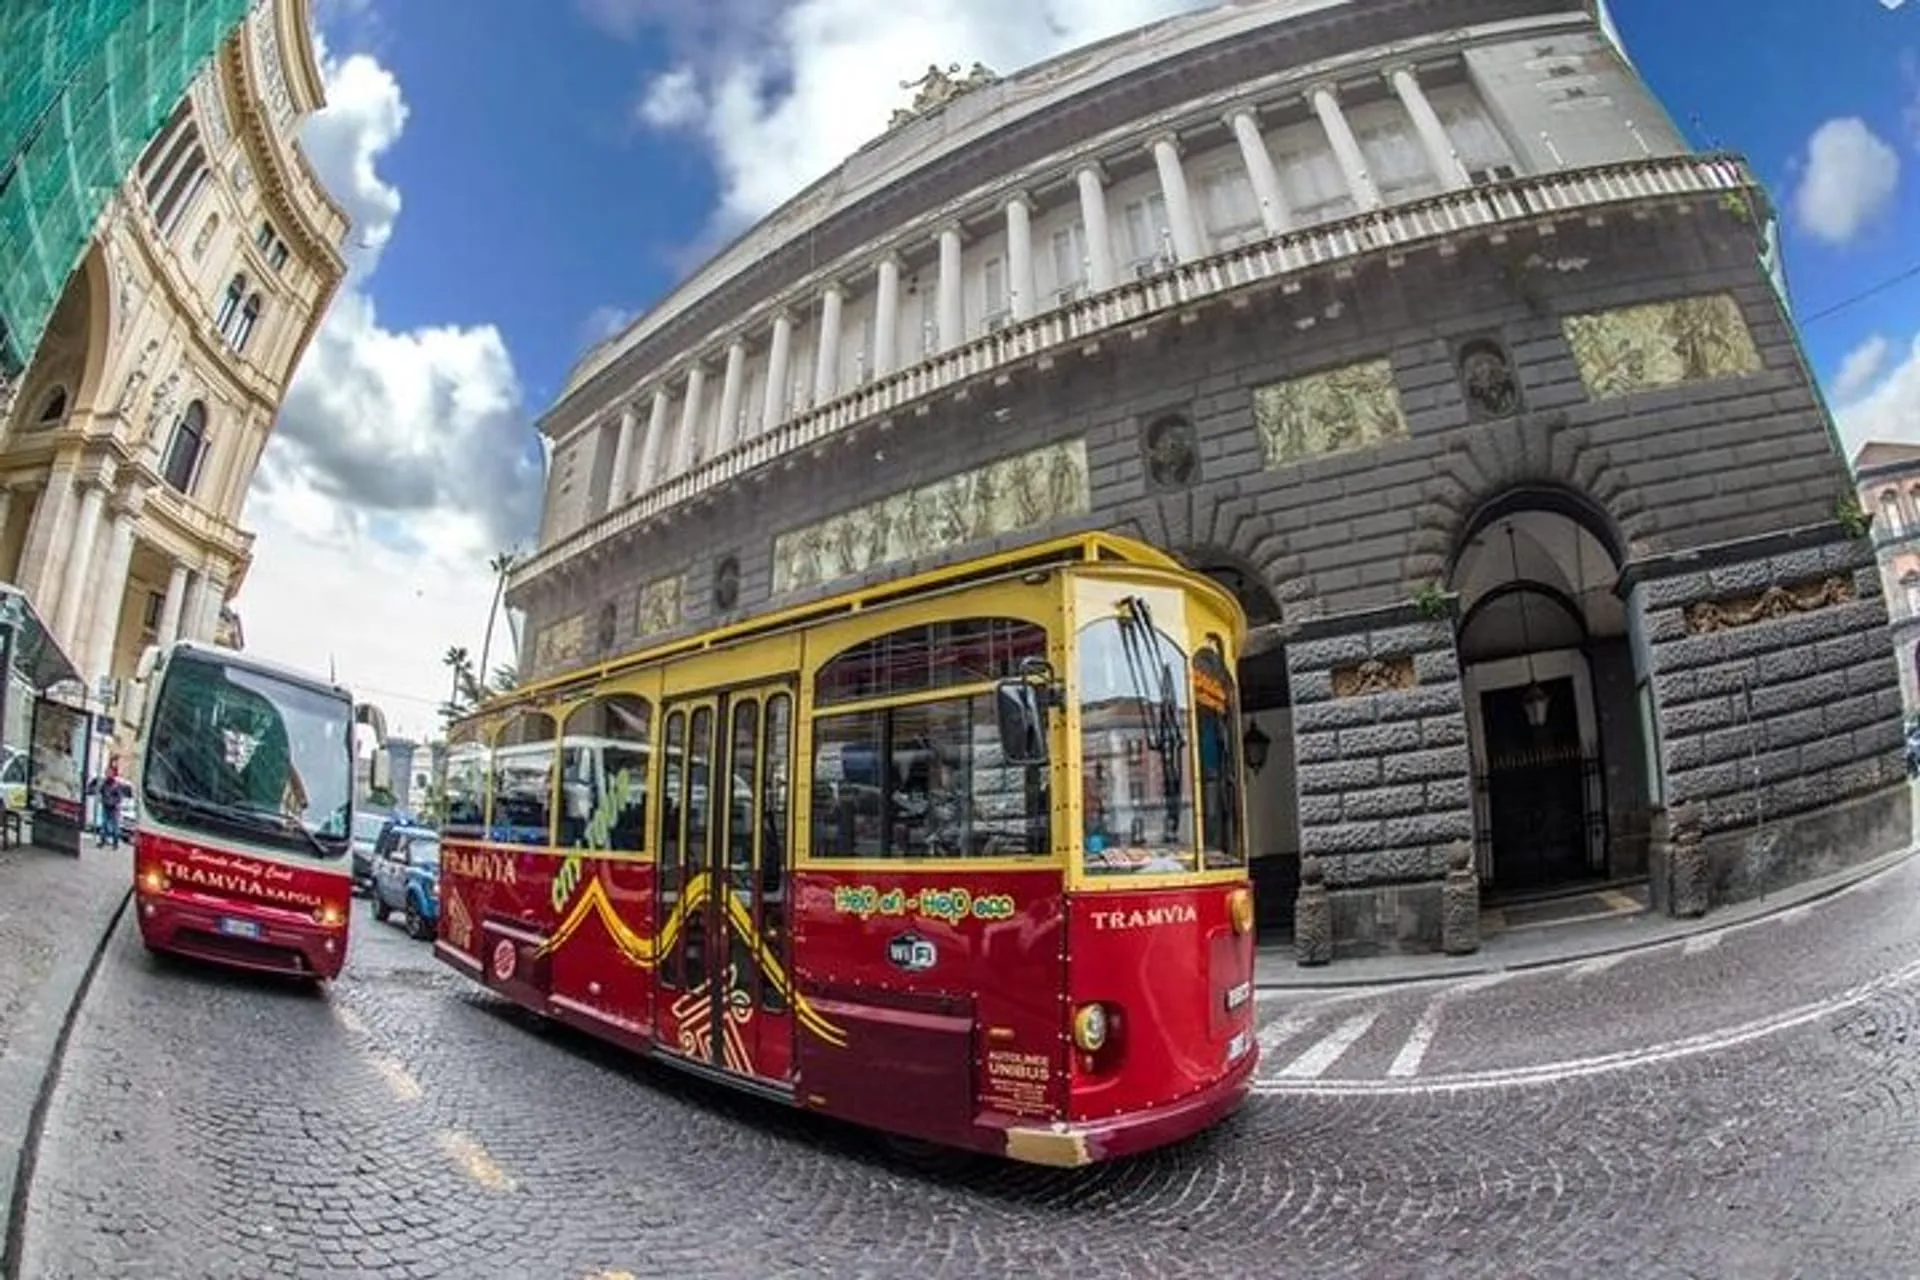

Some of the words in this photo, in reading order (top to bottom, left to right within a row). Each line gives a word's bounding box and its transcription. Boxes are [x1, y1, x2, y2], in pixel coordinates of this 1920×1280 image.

[442, 850, 517, 884] TRAMVIA
[163, 859, 264, 896] TRAMVIA
[266, 886, 322, 906] NAPOLI
[1090, 904, 1198, 930] TRAMVIA
[988, 1061, 1050, 1081] UNIBUS
